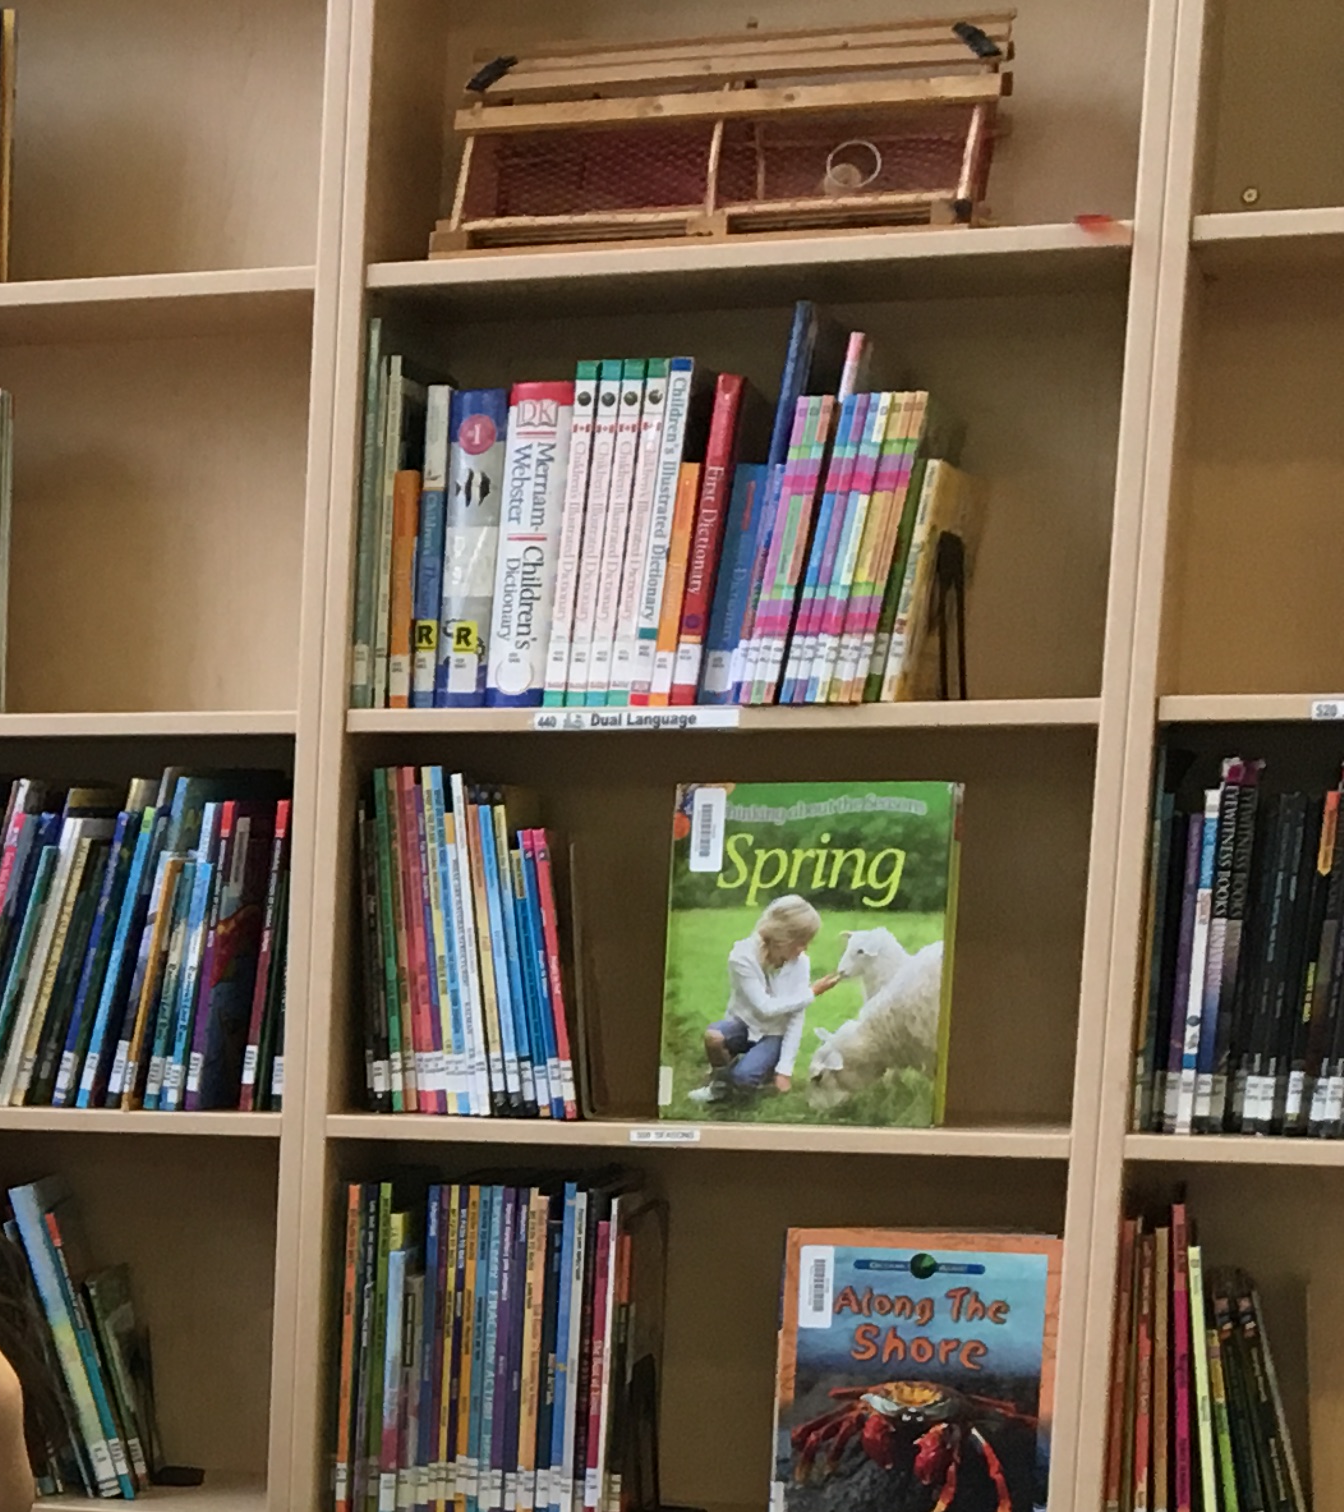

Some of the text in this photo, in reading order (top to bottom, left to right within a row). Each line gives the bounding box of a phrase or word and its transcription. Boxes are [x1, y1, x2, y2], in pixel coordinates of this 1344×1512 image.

[516, 399, 559, 427] DK
[508, 444, 533, 525] Webster
[530, 442, 556, 532] Merriam-
[641, 376, 689, 621] Children's Illustrated Dictionary
[687, 464, 725, 595] First Dictionary
[498, 558, 521, 641] Dictionary
[515, 546, 544, 650] Children's
[417, 625, 434, 648] R
[455, 626, 473, 649] R
[590, 712, 622, 727] Dual
[626, 711, 698, 730] Language
[725, 802, 786, 826] hinking
[1213, 784, 1239, 917] EYEWITNESS BOOKS
[716, 832, 906, 908] Spring
[833, 1285, 1012, 1326] Along The
[850, 1323, 989, 1370] Shore
